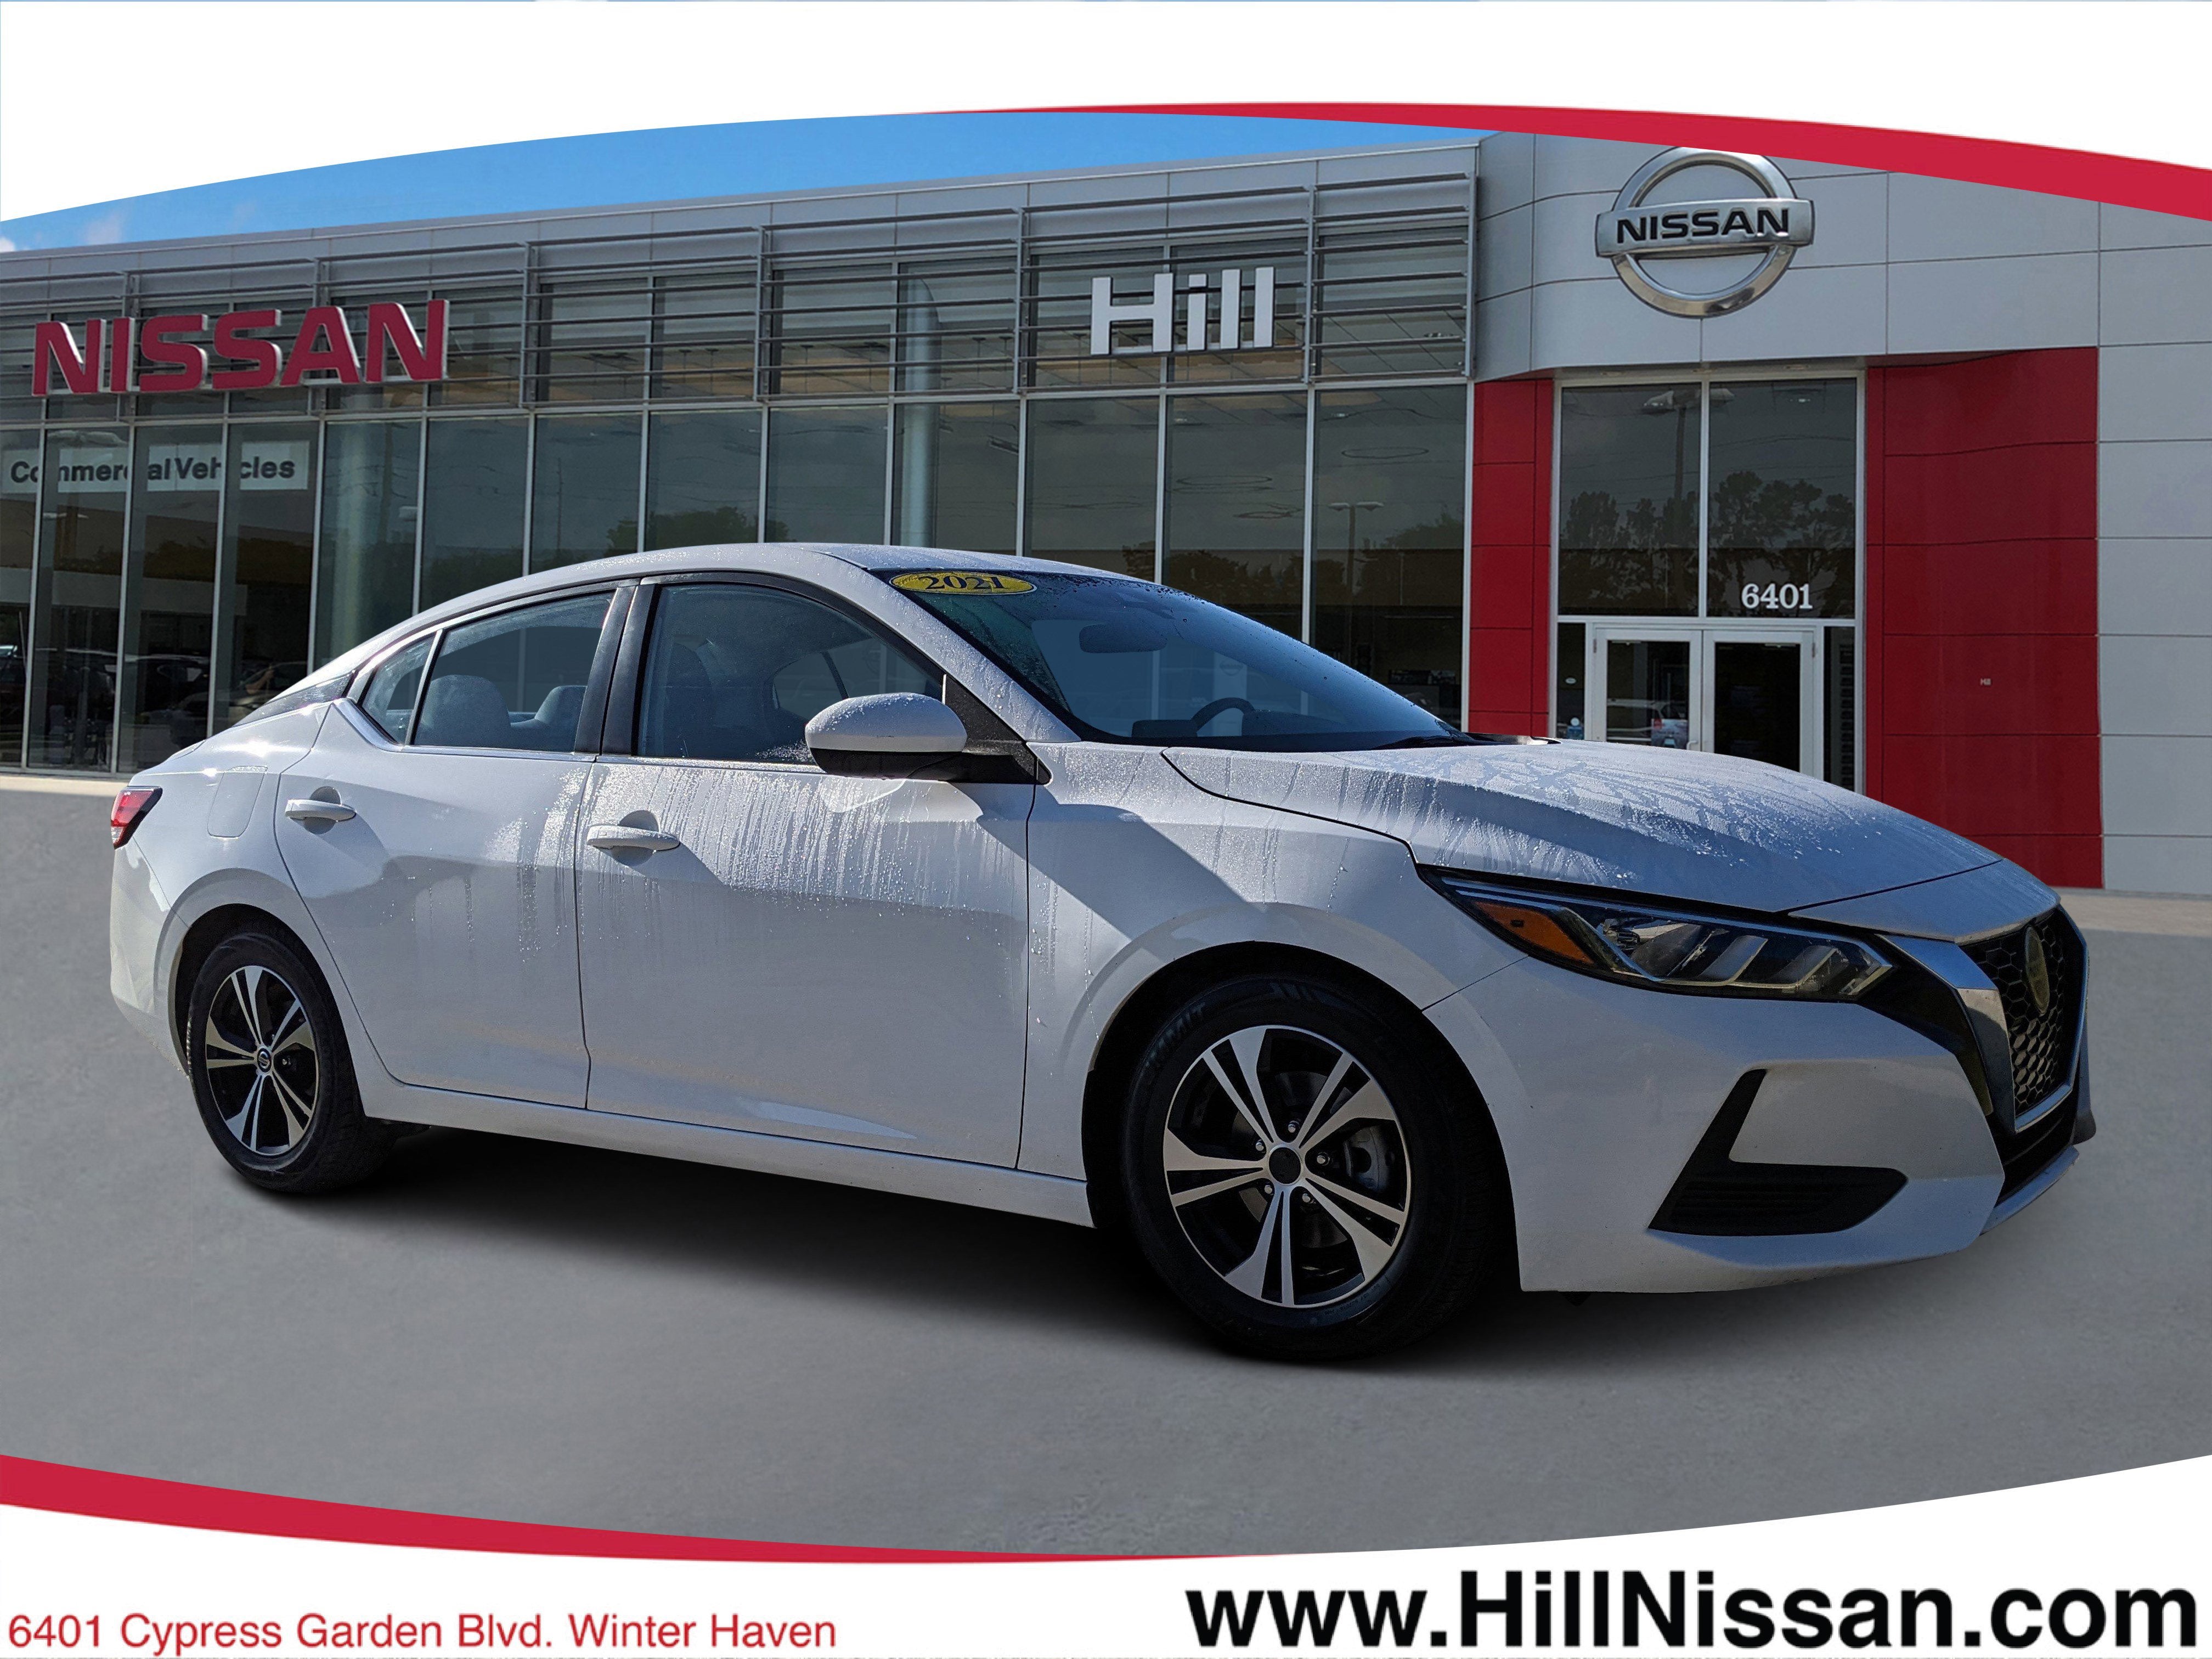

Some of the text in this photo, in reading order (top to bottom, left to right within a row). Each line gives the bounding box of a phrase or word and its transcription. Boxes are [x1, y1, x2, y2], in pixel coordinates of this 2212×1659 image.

[1617, 208, 1788, 243] NISSAN
[1091, 267, 1274, 354] Hill
[32, 300, 449, 396] NISSAN
[10, 456, 295, 483] Cmeral Vehcles
[919, 575, 1006, 590] 2021
[1741, 583, 1813, 609] 6401
